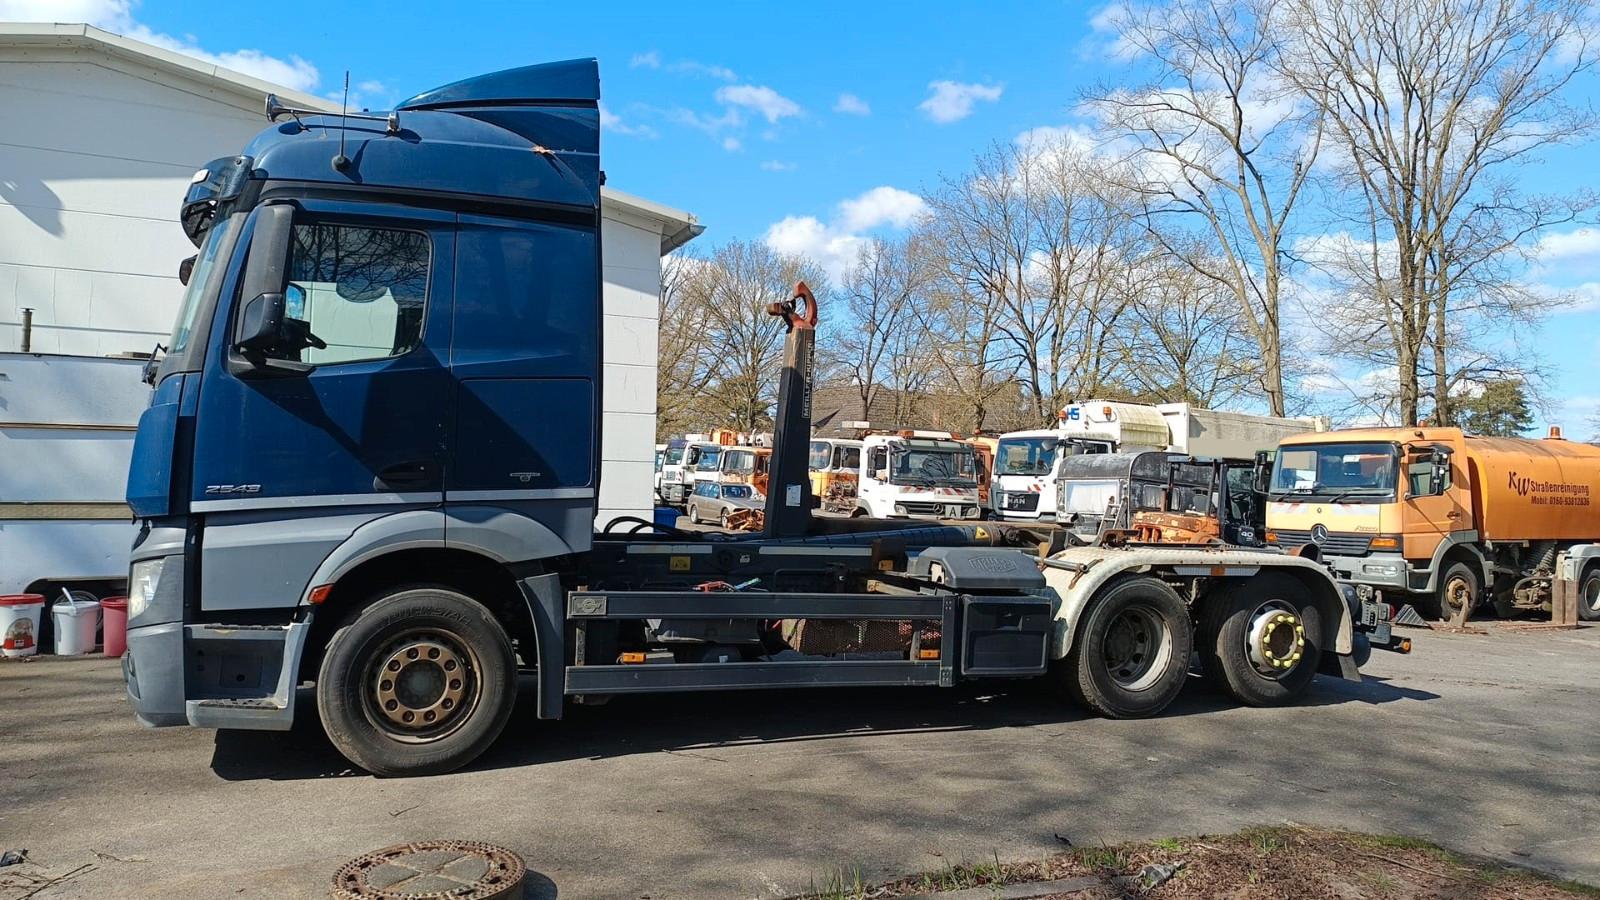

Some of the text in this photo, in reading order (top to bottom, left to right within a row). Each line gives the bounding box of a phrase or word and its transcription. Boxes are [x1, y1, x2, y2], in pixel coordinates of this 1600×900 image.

[1508, 471, 1589, 496] KW Straßenreinigung
[949, 506, 957, 517] A
